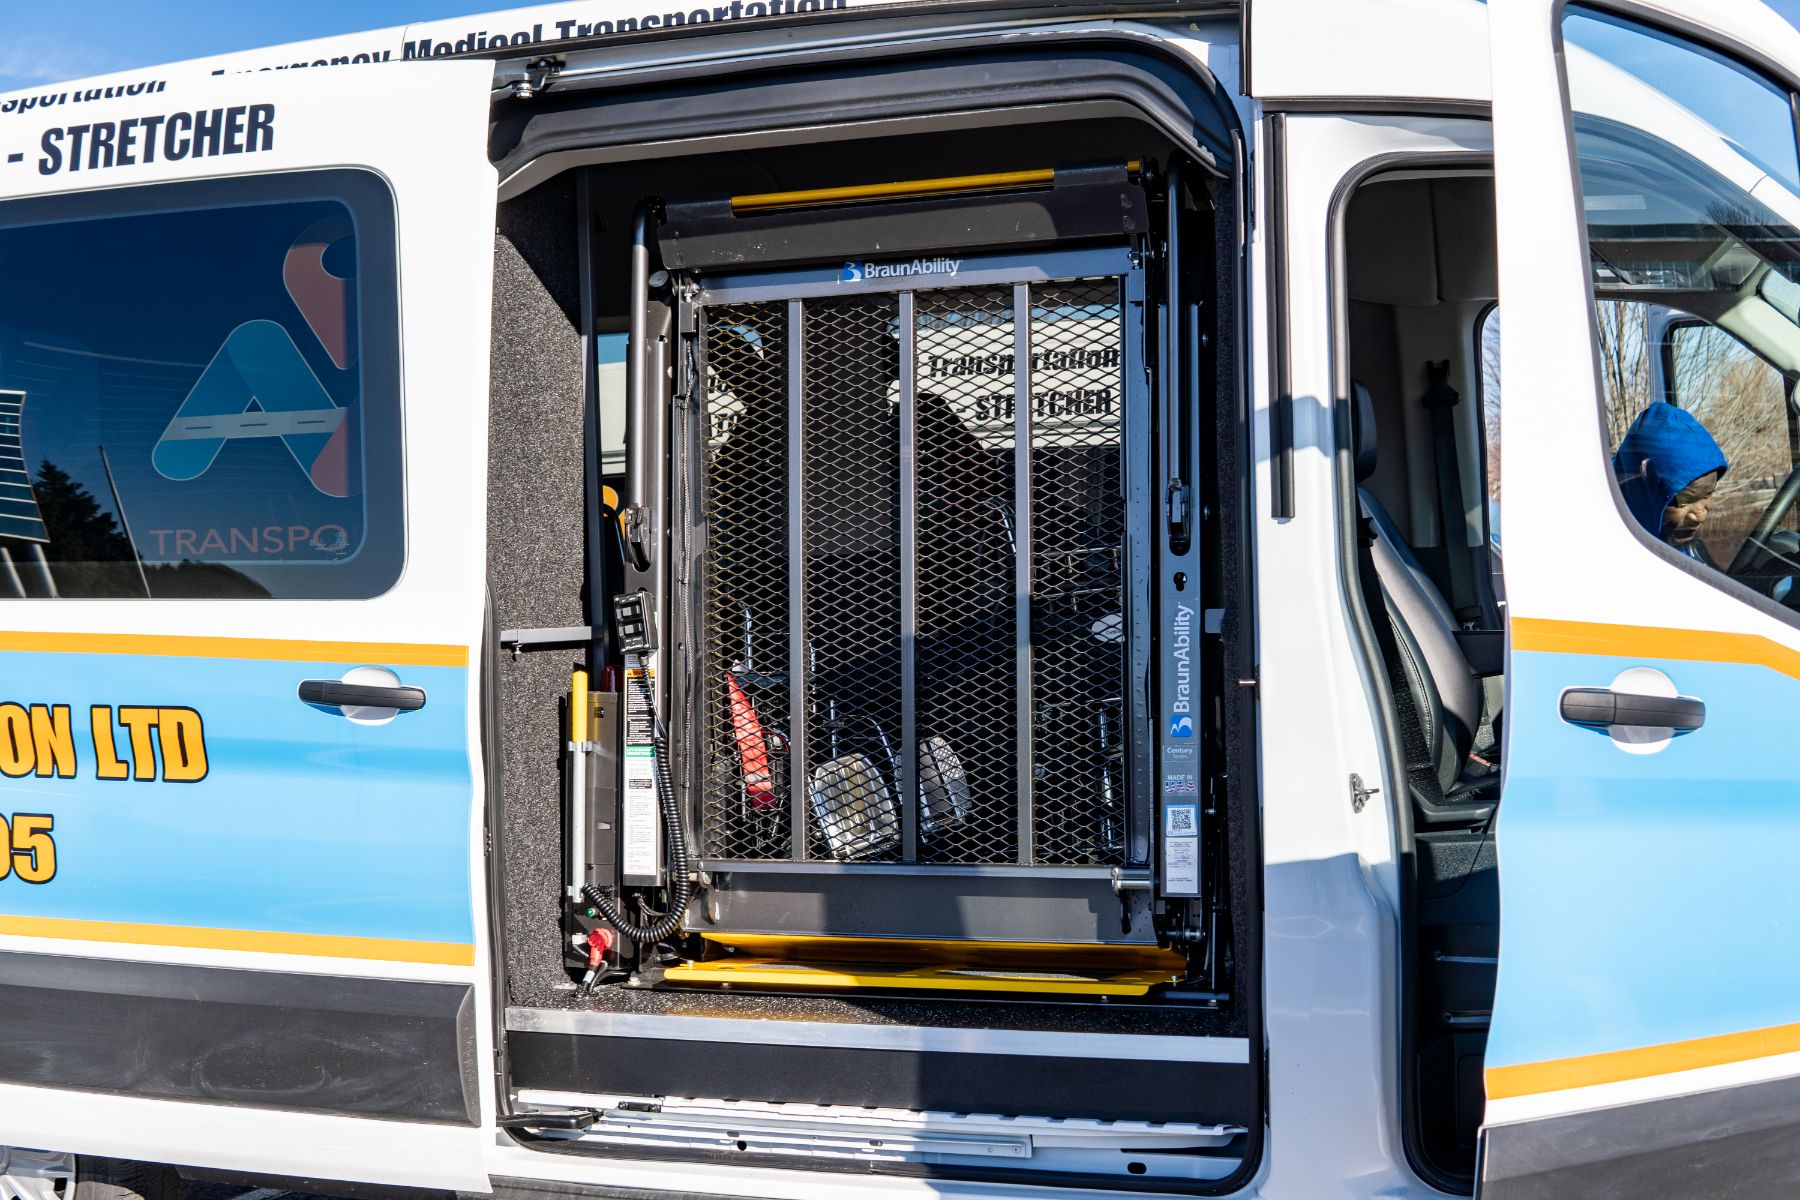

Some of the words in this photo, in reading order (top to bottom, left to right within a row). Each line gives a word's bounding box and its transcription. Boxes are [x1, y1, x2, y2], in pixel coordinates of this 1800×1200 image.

[38, 103, 275, 176] STRETCHER
[864, 257, 960, 279] BraunAbility
[149, 524, 348, 556] TRANSPO
[1173, 602, 1194, 713] BraunAbility
[0, 701, 77, 779] ON
[90, 704, 209, 783] LTD
[1166, 747, 1193, 755] Century
[1165, 780, 1196, 793] USA
